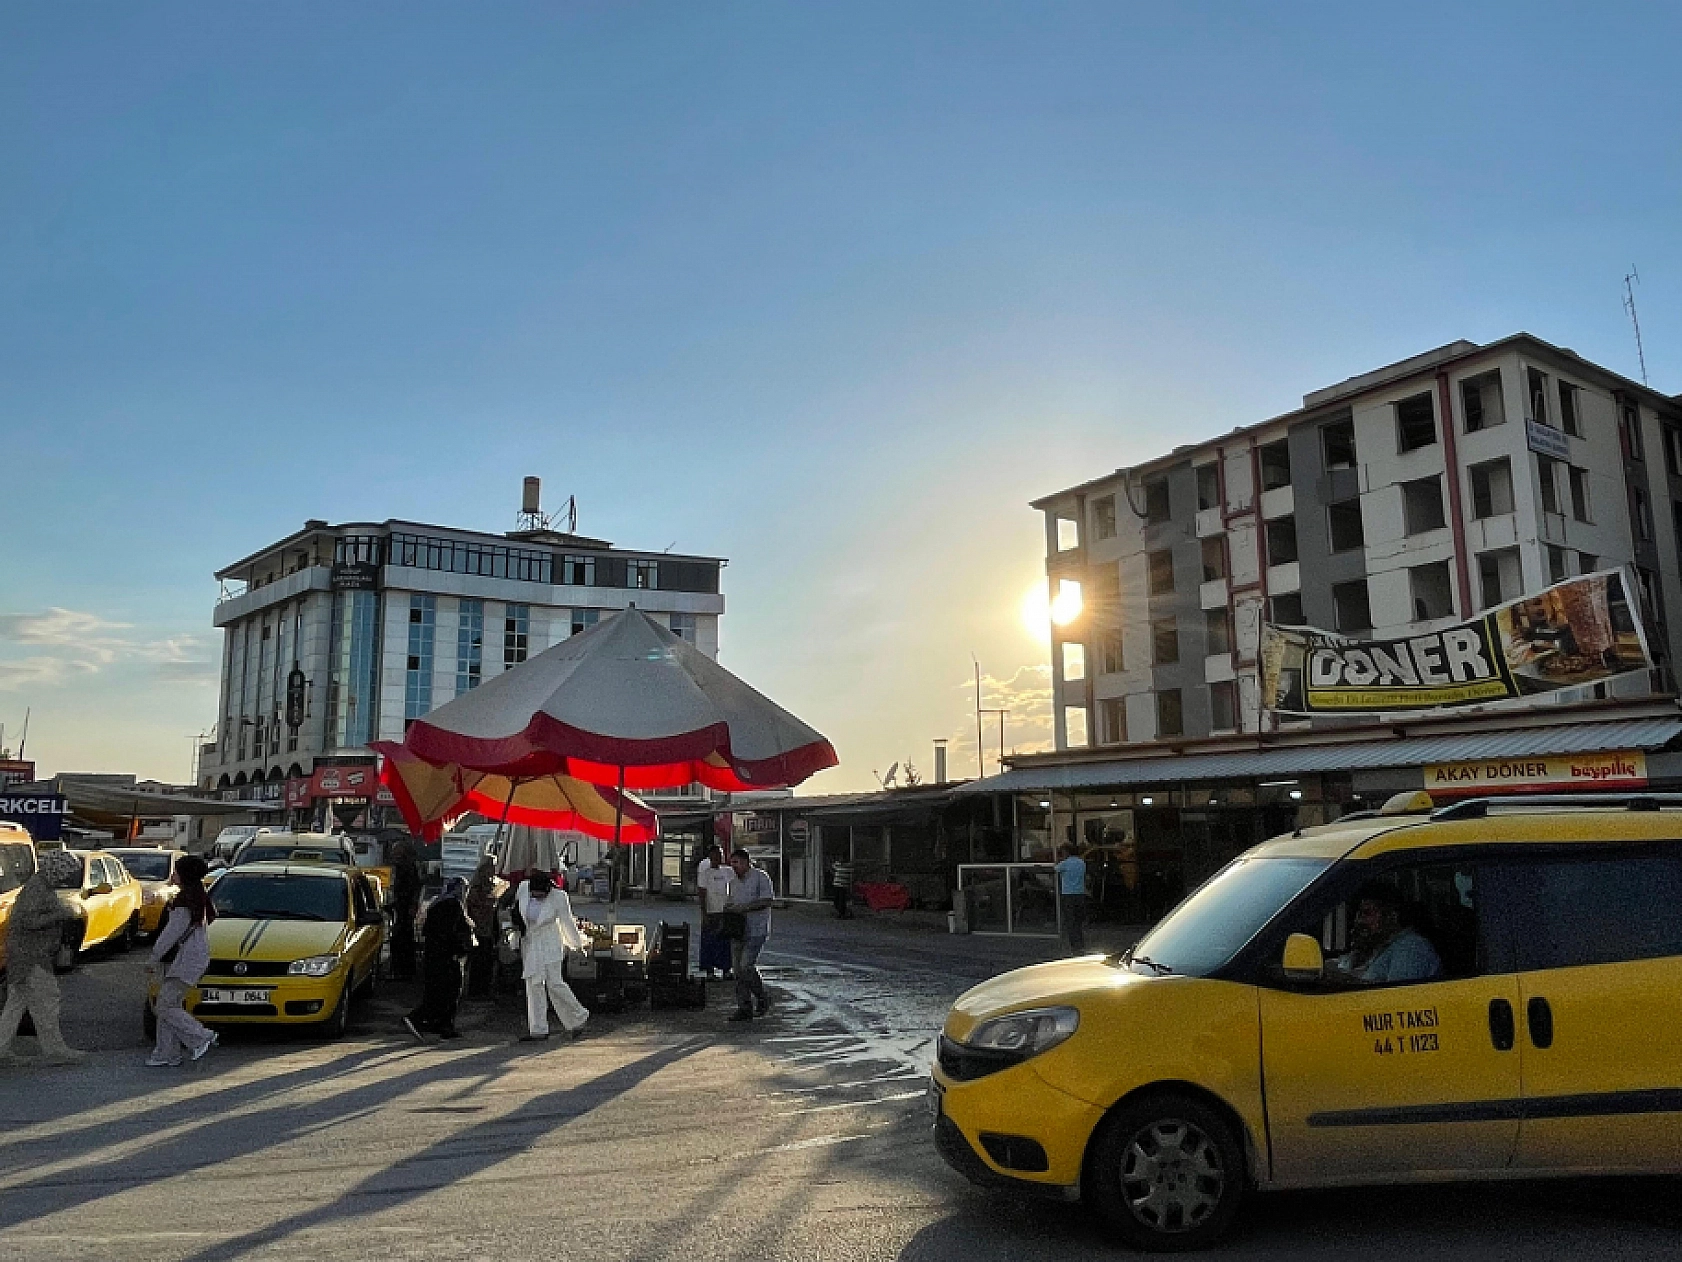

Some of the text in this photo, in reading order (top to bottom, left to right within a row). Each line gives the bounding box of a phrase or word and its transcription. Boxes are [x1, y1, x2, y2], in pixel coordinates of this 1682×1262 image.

[1435, 761, 1549, 783] AKAY DÖNER
[1363, 1005, 1440, 1033] NUR TAKSİ
[1374, 1036, 1394, 1055] 44
[1396, 1035, 1405, 1053] T
